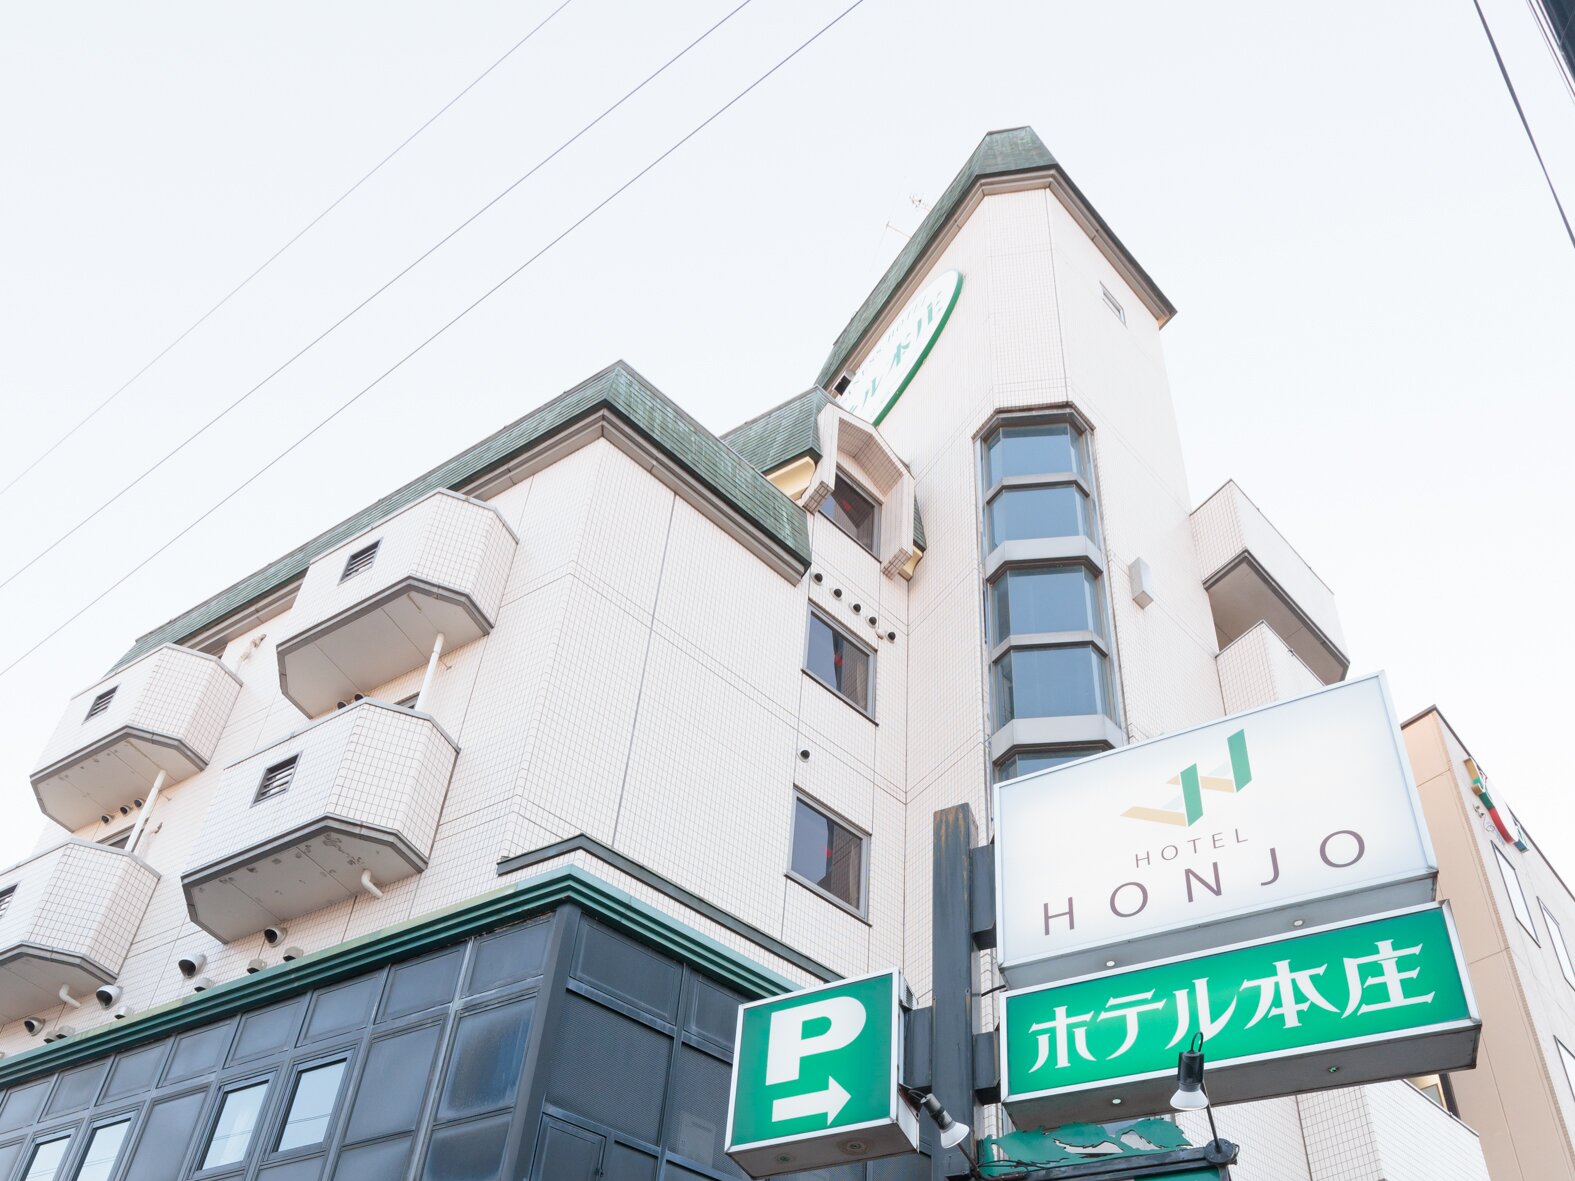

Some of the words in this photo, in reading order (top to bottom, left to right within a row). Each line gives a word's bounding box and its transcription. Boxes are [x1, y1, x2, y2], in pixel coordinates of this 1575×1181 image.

[1044, 830, 1365, 936] HONJO
[1135, 828, 1249, 869] HOTEL
[766, 996, 867, 1086] P
[1029, 939, 1435, 1073] ホテル本庄
